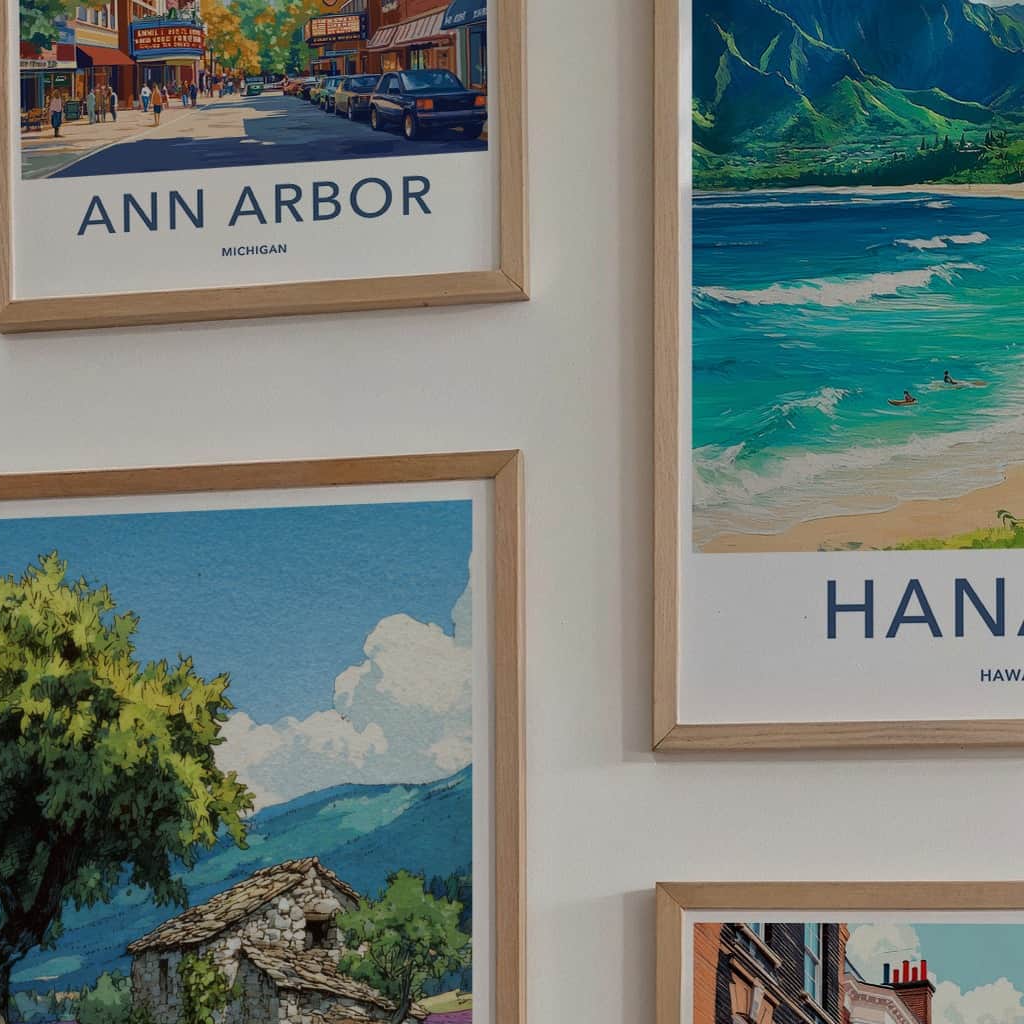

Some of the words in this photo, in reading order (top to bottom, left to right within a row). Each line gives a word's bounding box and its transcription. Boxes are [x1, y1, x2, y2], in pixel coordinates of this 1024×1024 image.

[77, 188, 205, 237] ANN
[228, 174, 433, 227] ARBOR
[221, 243, 288, 257] MICHIGAN
